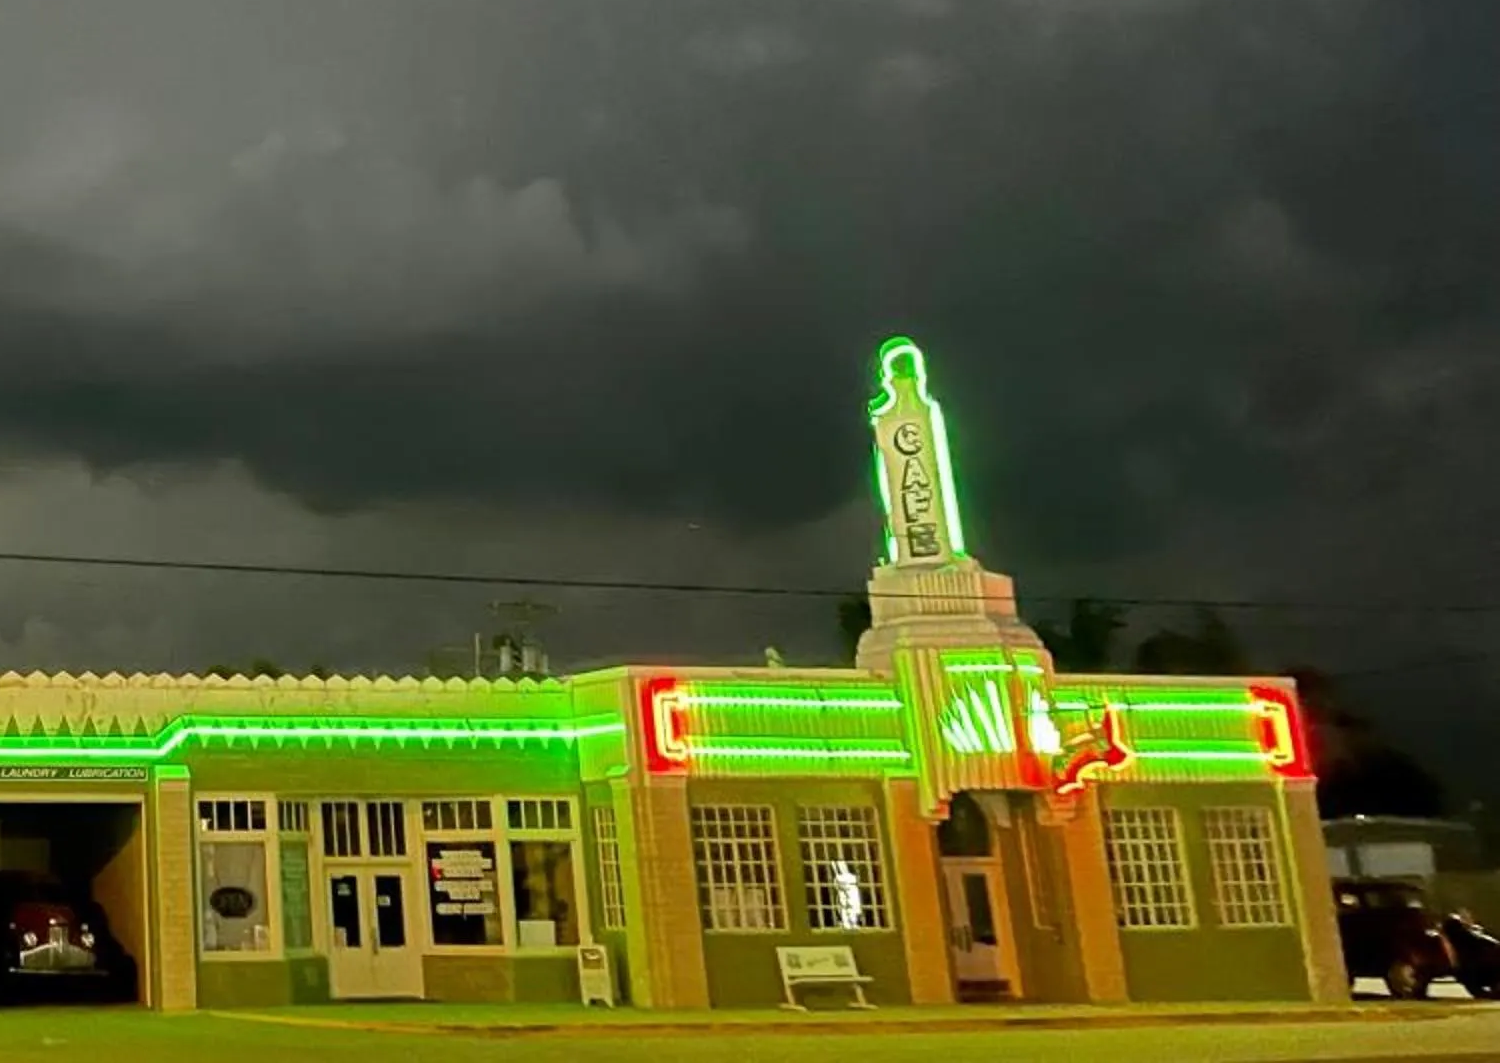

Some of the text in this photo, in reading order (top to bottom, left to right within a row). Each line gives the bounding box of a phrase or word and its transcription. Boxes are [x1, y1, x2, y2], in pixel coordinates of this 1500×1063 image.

[894, 422, 940, 557] CAFE
[1, 768, 58, 778] LAUNDRY
[68, 768, 145, 778] LUBRICATION
